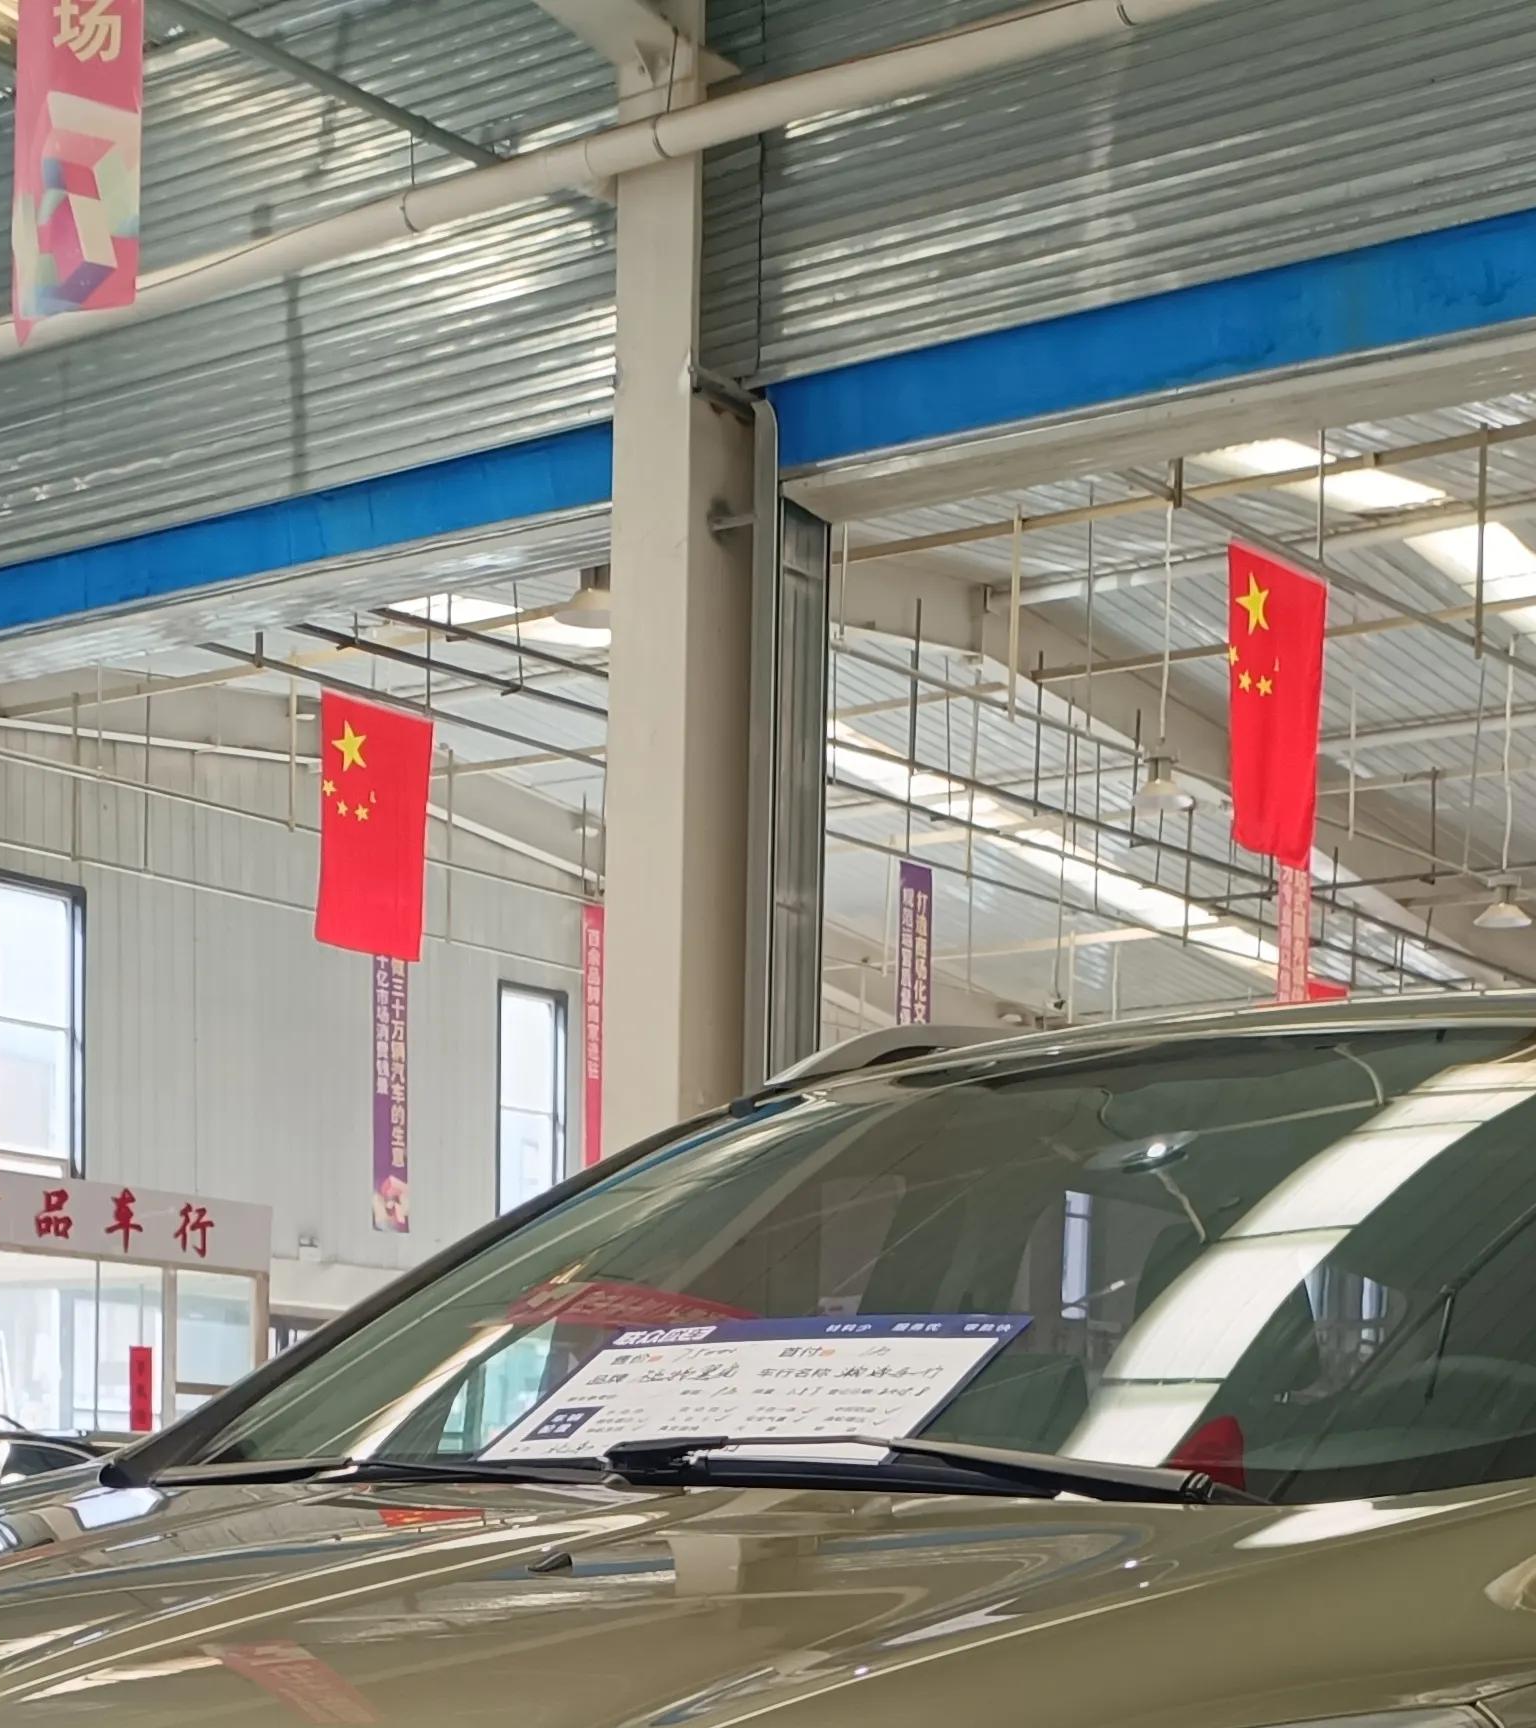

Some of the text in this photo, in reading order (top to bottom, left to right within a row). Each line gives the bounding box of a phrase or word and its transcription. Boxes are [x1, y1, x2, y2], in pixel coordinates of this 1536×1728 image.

[52, 0, 122, 62] 场
[756, 1366, 833, 1379] 车行名称
